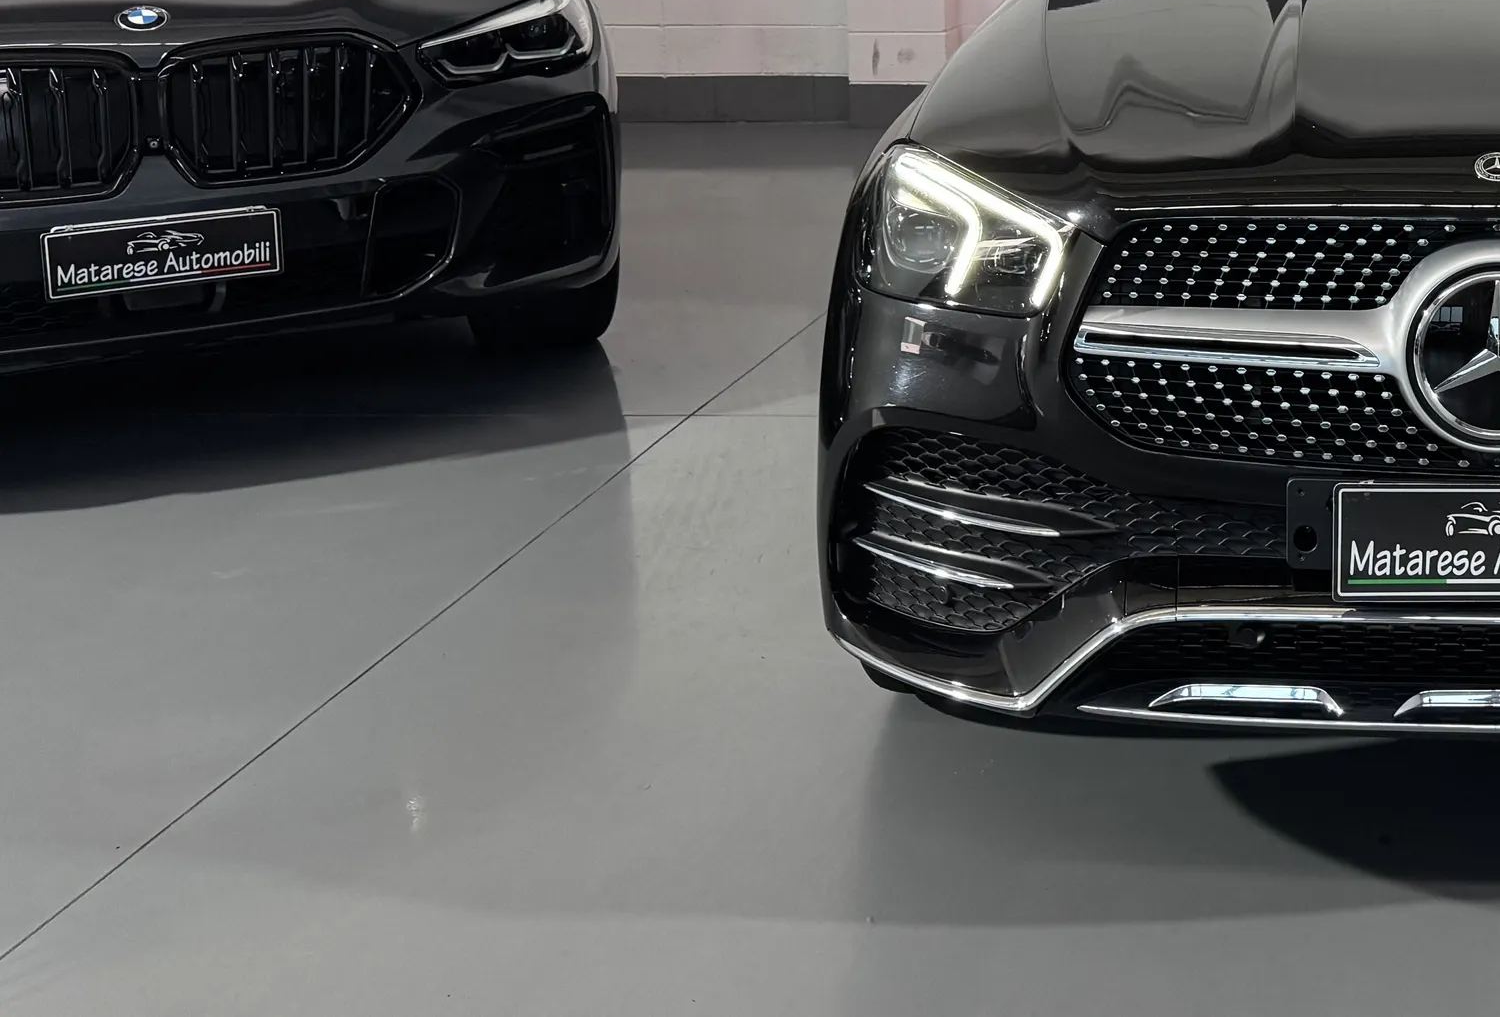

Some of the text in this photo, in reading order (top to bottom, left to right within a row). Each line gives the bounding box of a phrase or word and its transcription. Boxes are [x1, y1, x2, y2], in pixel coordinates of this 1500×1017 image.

[57, 241, 271, 287] Matarese Automobili
[1350, 540, 1486, 576] Matarese
